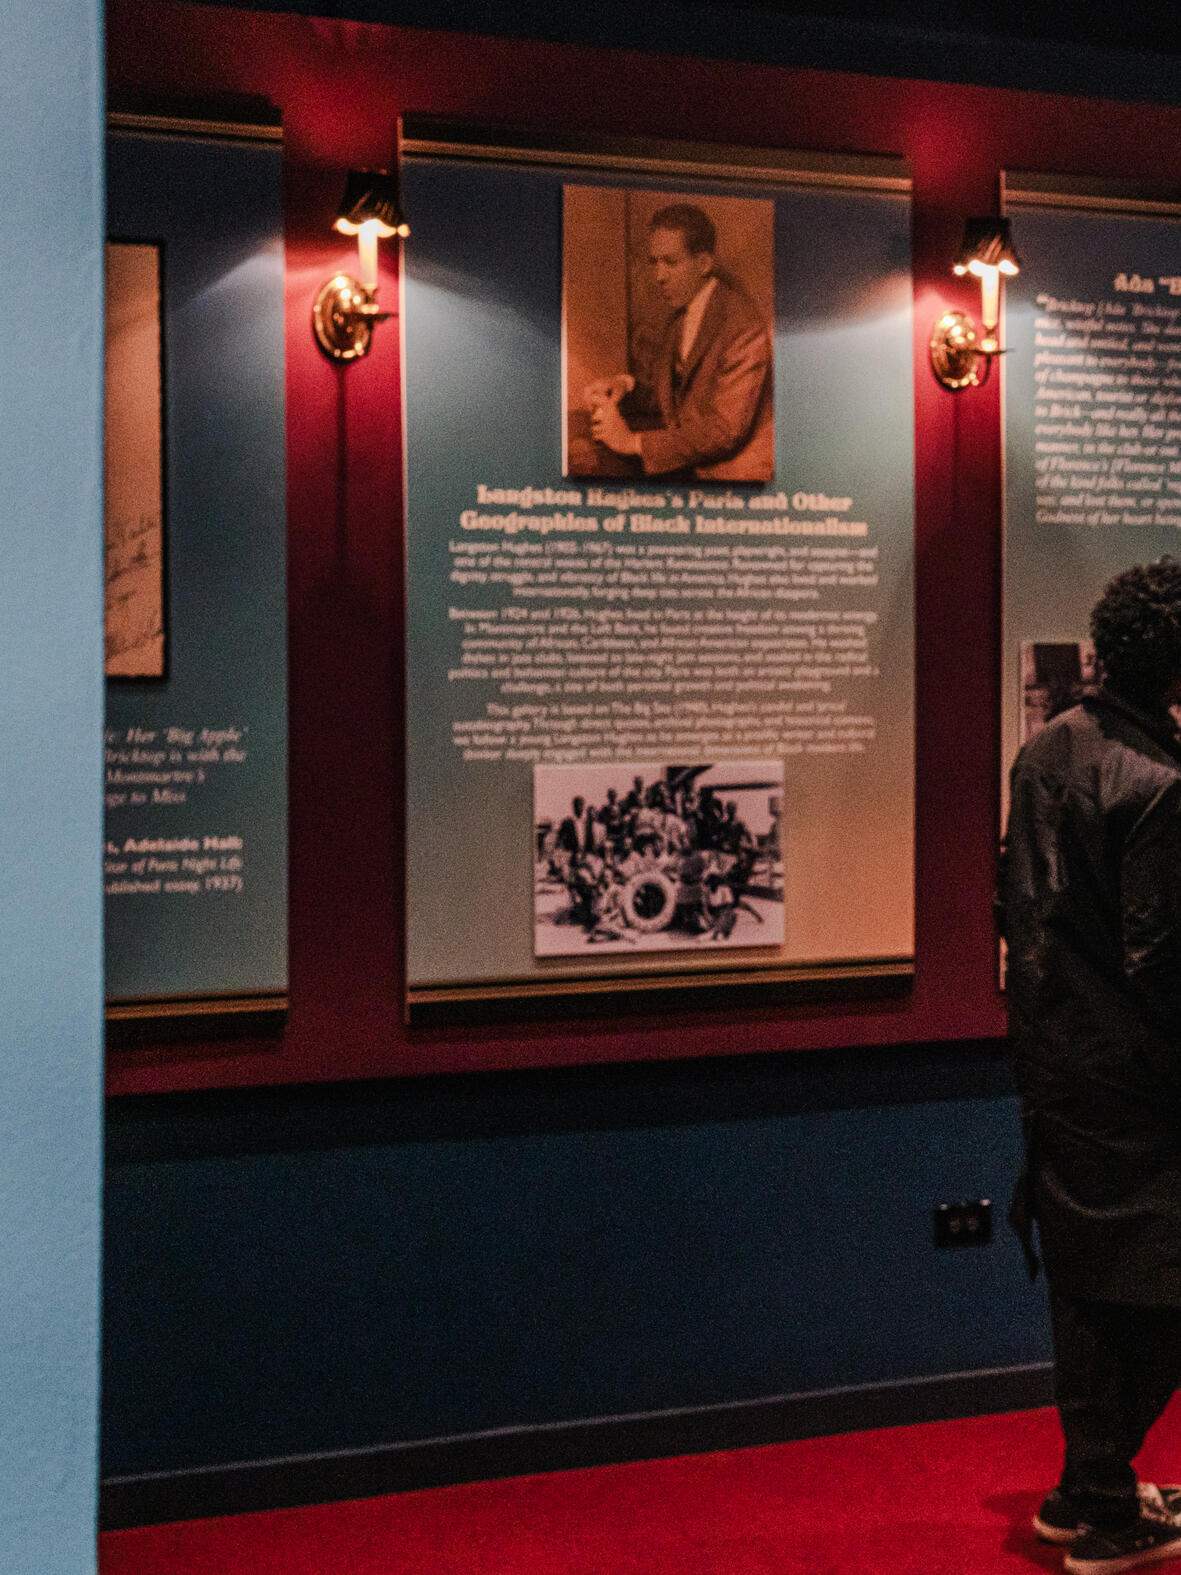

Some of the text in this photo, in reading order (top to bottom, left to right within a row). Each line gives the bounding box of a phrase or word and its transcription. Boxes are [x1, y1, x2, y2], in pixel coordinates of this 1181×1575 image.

[1114, 273, 1154, 292] Ada
[477, 484, 583, 509] Langston
[689, 490, 744, 509] Paris
[748, 492, 788, 509] and
[792, 491, 853, 511] Other
[460, 510, 868, 536] Geographies of Black Internationalism
